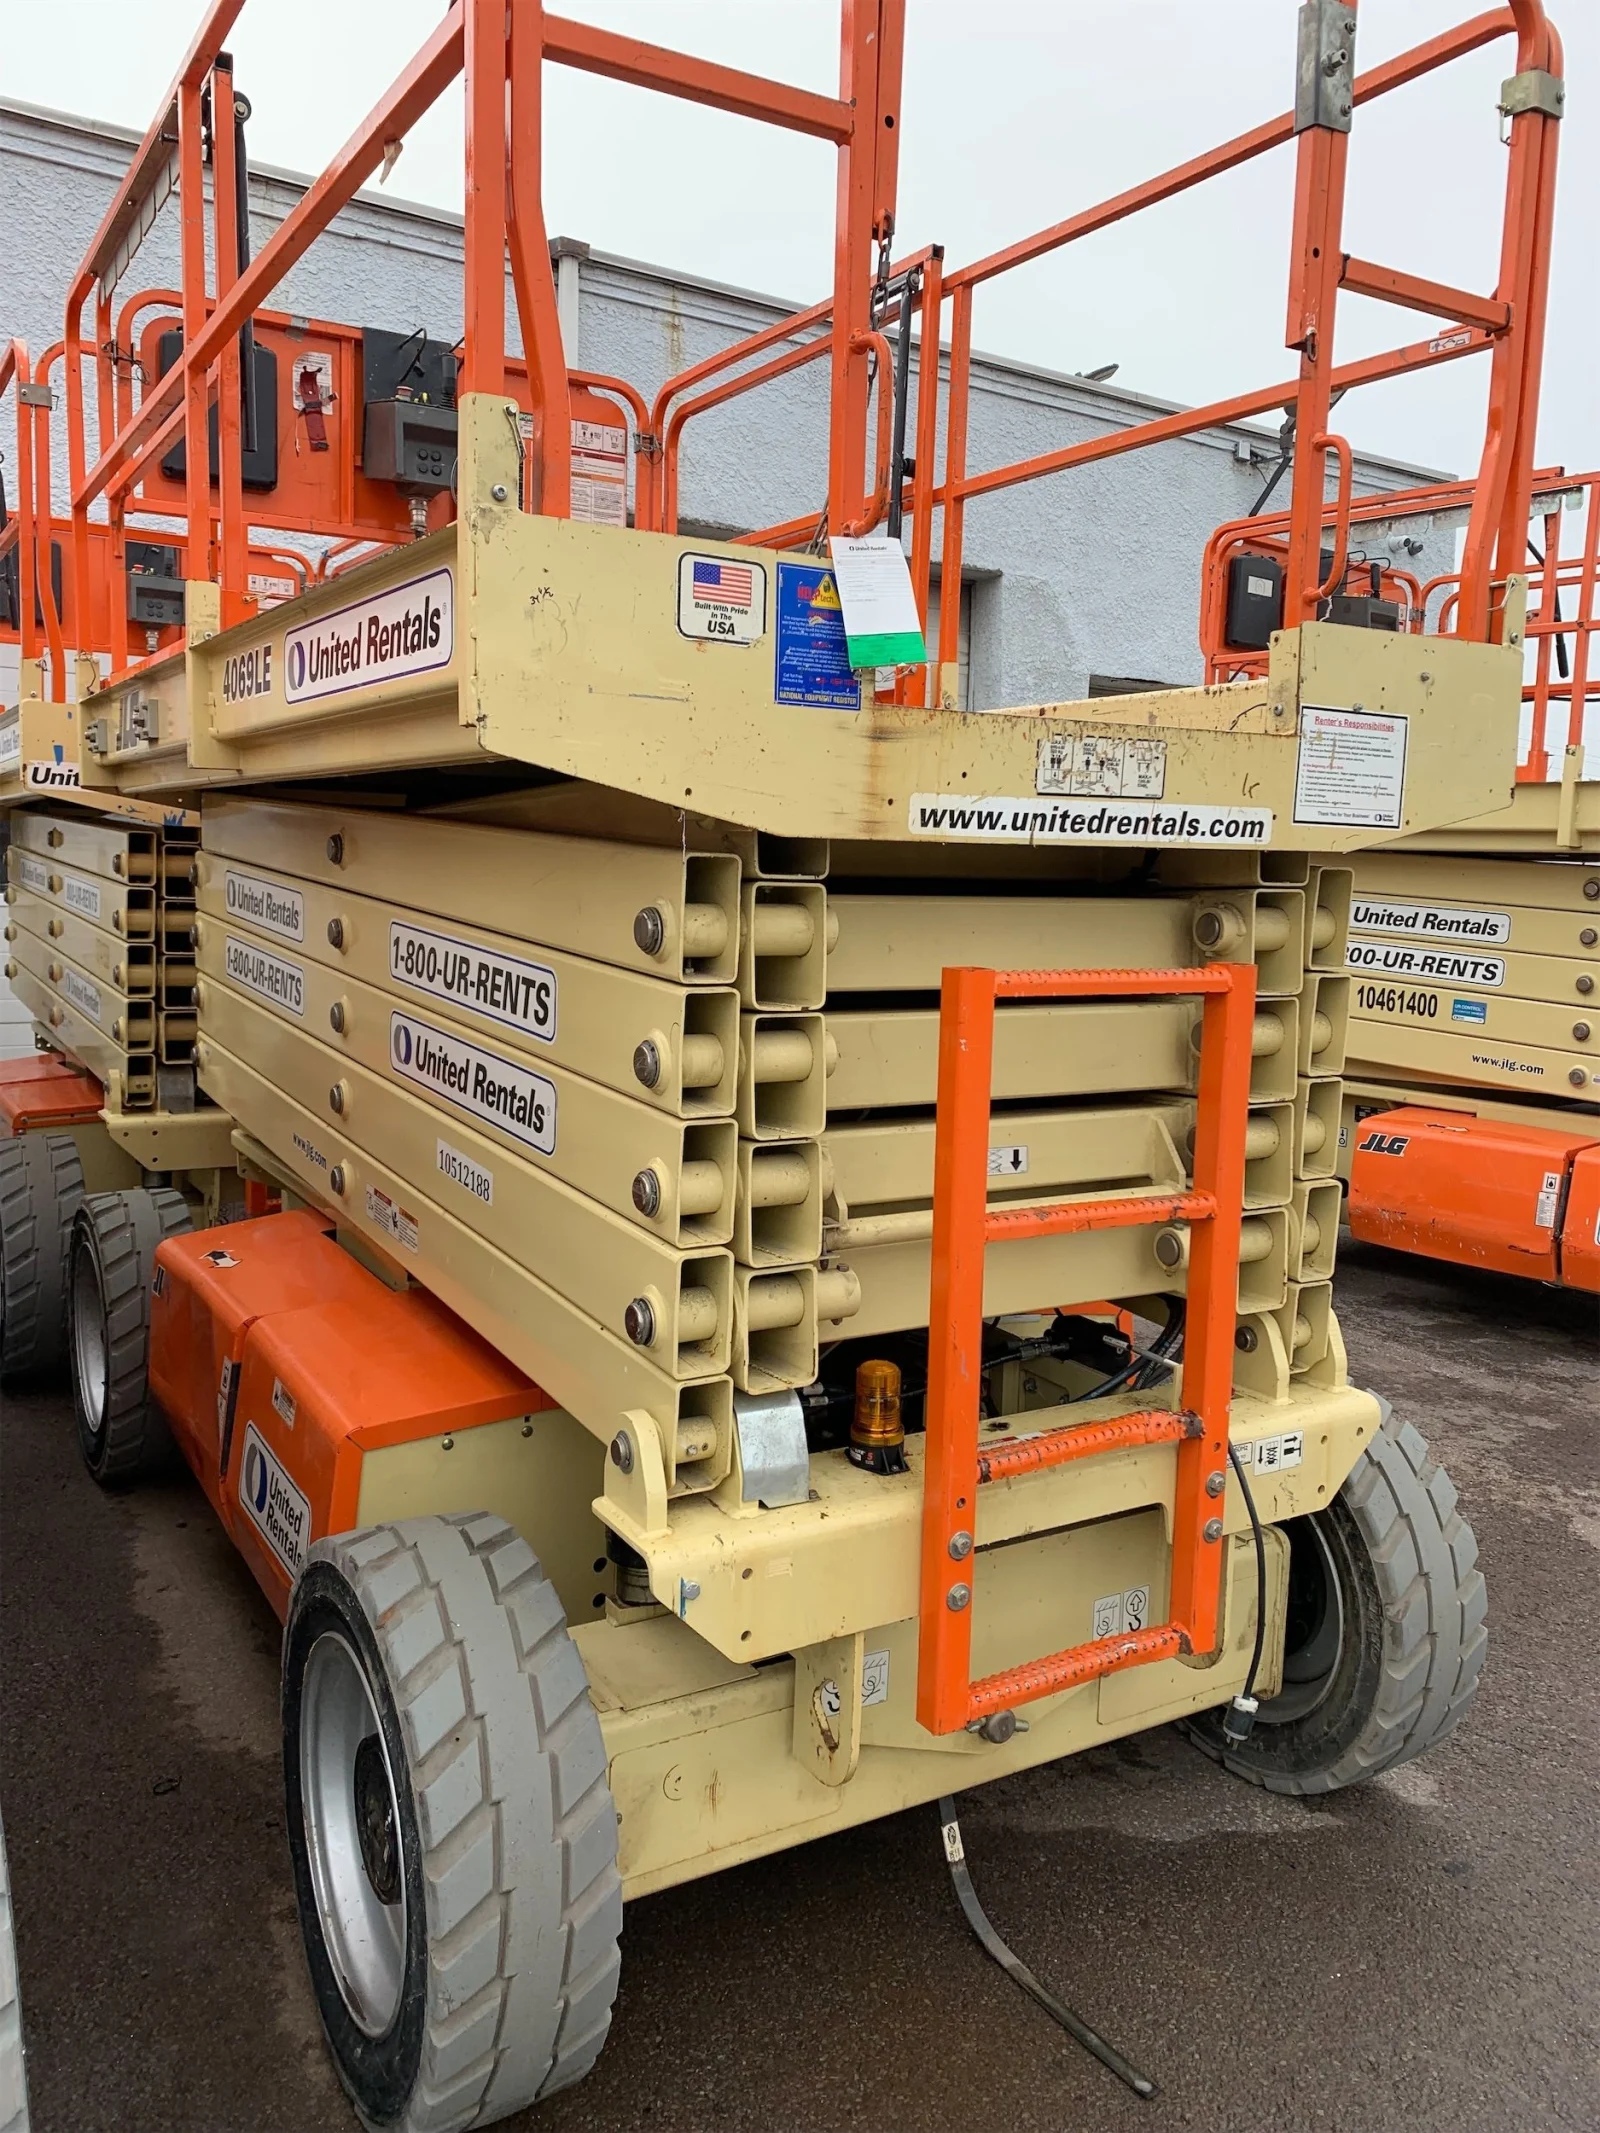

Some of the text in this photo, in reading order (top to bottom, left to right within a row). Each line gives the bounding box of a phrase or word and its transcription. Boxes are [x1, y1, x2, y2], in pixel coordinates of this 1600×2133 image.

[694, 601, 748, 615] Built With Pride
[309, 596, 441, 683] United Rentals
[707, 620, 735, 635] USA
[223, 645, 272, 703] 4069LE
[779, 691, 803, 701] NATIONAL
[804, 693, 832, 703] EQUIPMENT
[833, 696, 857, 705] REGISTER
[1314, 715, 1395, 733] Renter's Responsibilities
[920, 806, 1265, 838] www.unitedrentals.com
[237, 883, 299, 930] United Rentals
[1353, 906, 1499, 936] United Rentals
[227, 946, 302, 1006] 1-800-UR-RENTS
[393, 936, 551, 1027] 1-800-UR-RENTS
[1357, 985, 1438, 1018] 10461400
[1471, 1054, 1545, 1075] www.jlg.com
[415, 1035, 545, 1134] United Rentals
[293, 1132, 327, 1170] www.jlg.com
[1360, 1135, 1409, 1156] JLG
[439, 1149, 490, 1202] 10512188
[269, 1471, 303, 1537] United
